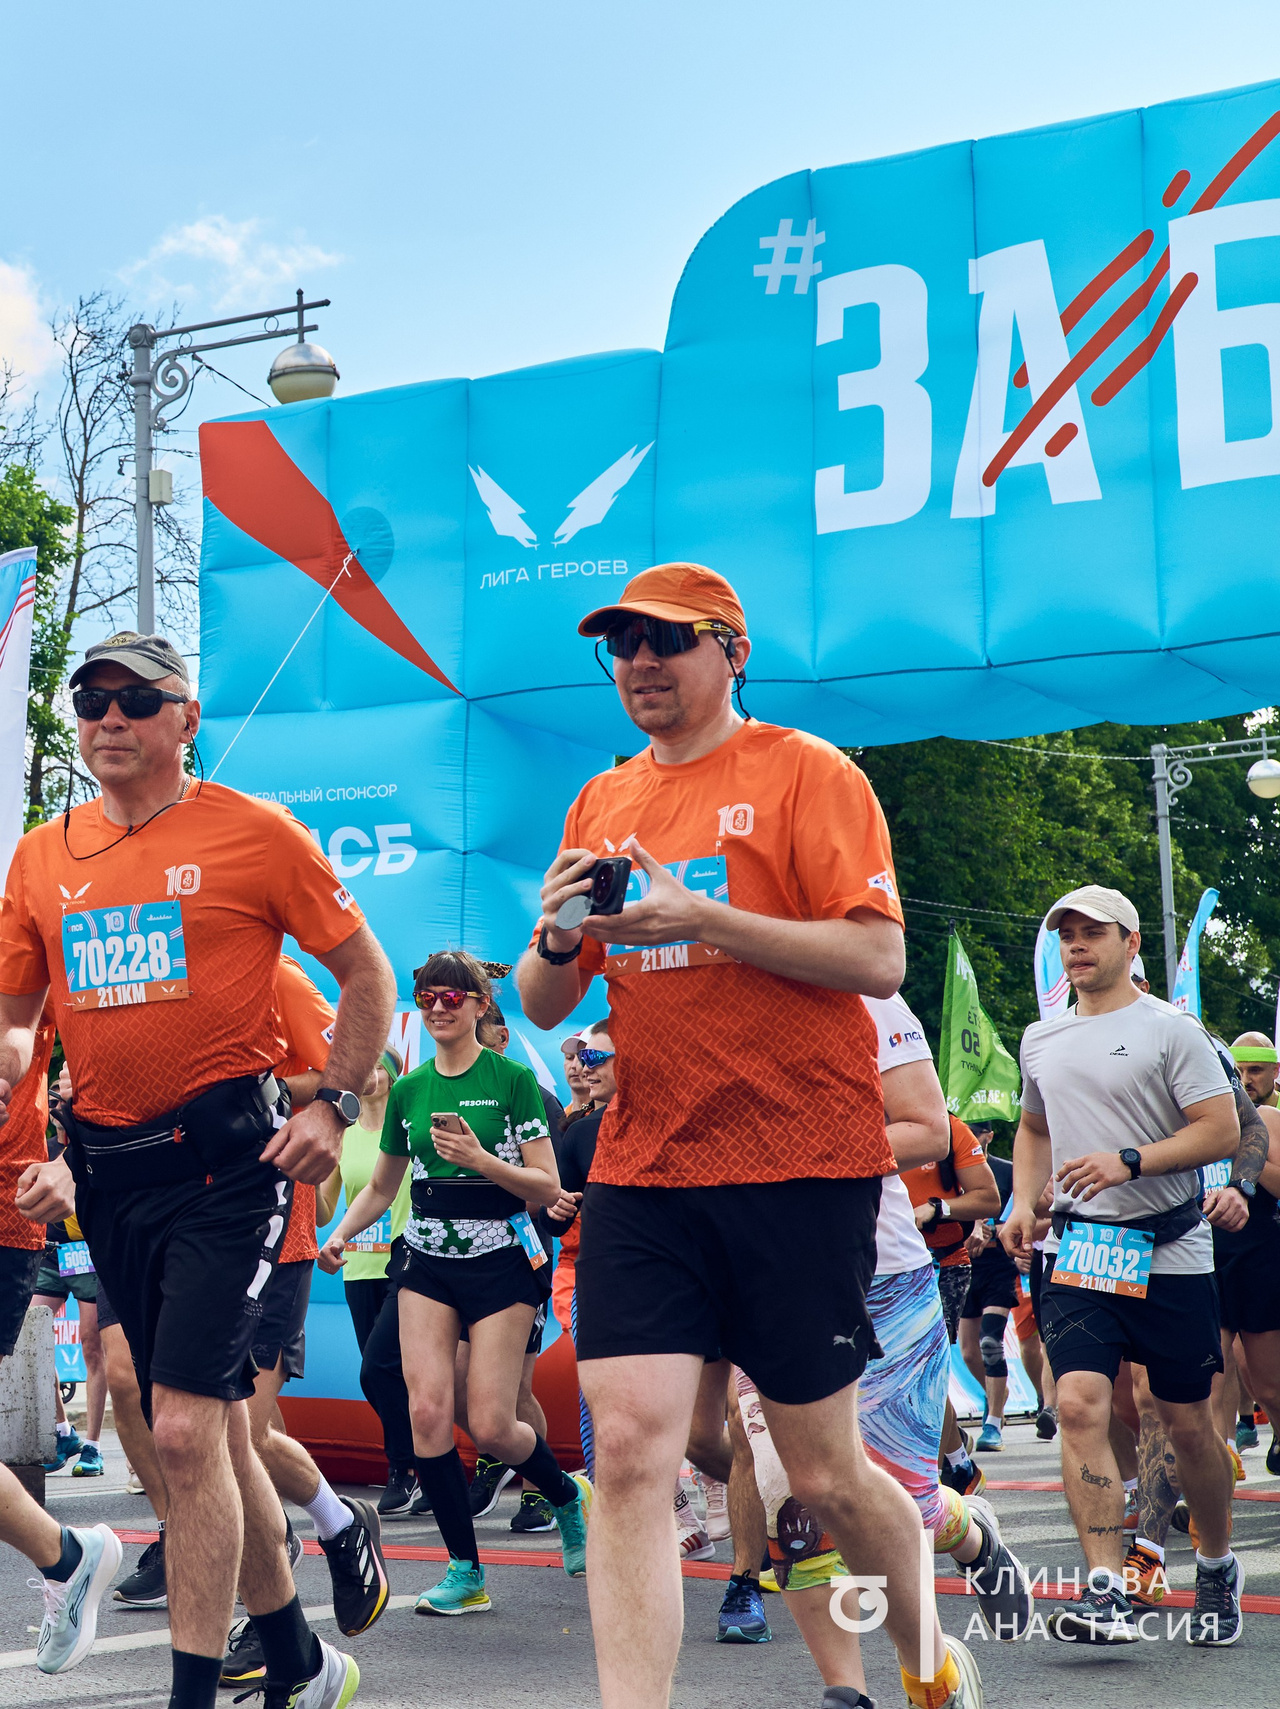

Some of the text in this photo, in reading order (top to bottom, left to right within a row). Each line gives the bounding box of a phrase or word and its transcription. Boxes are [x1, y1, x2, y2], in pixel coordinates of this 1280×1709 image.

[480, 560, 628, 589] ЛИГА ГЕРОЕВ
[246, 784, 398, 804] ЕРАЛЬНЫЙ СПОНСОР
[717, 803, 755, 836] 10
[310, 823, 418, 879] СБ
[164, 863, 201, 896] 10
[72, 931, 170, 988] 70228
[641, 944, 689, 972] 21.1KM
[97, 983, 146, 1008] 21.1KM
[1066, 1240, 1140, 1281] 70032
[1079, 1273, 1117, 1294] 21.1KM
